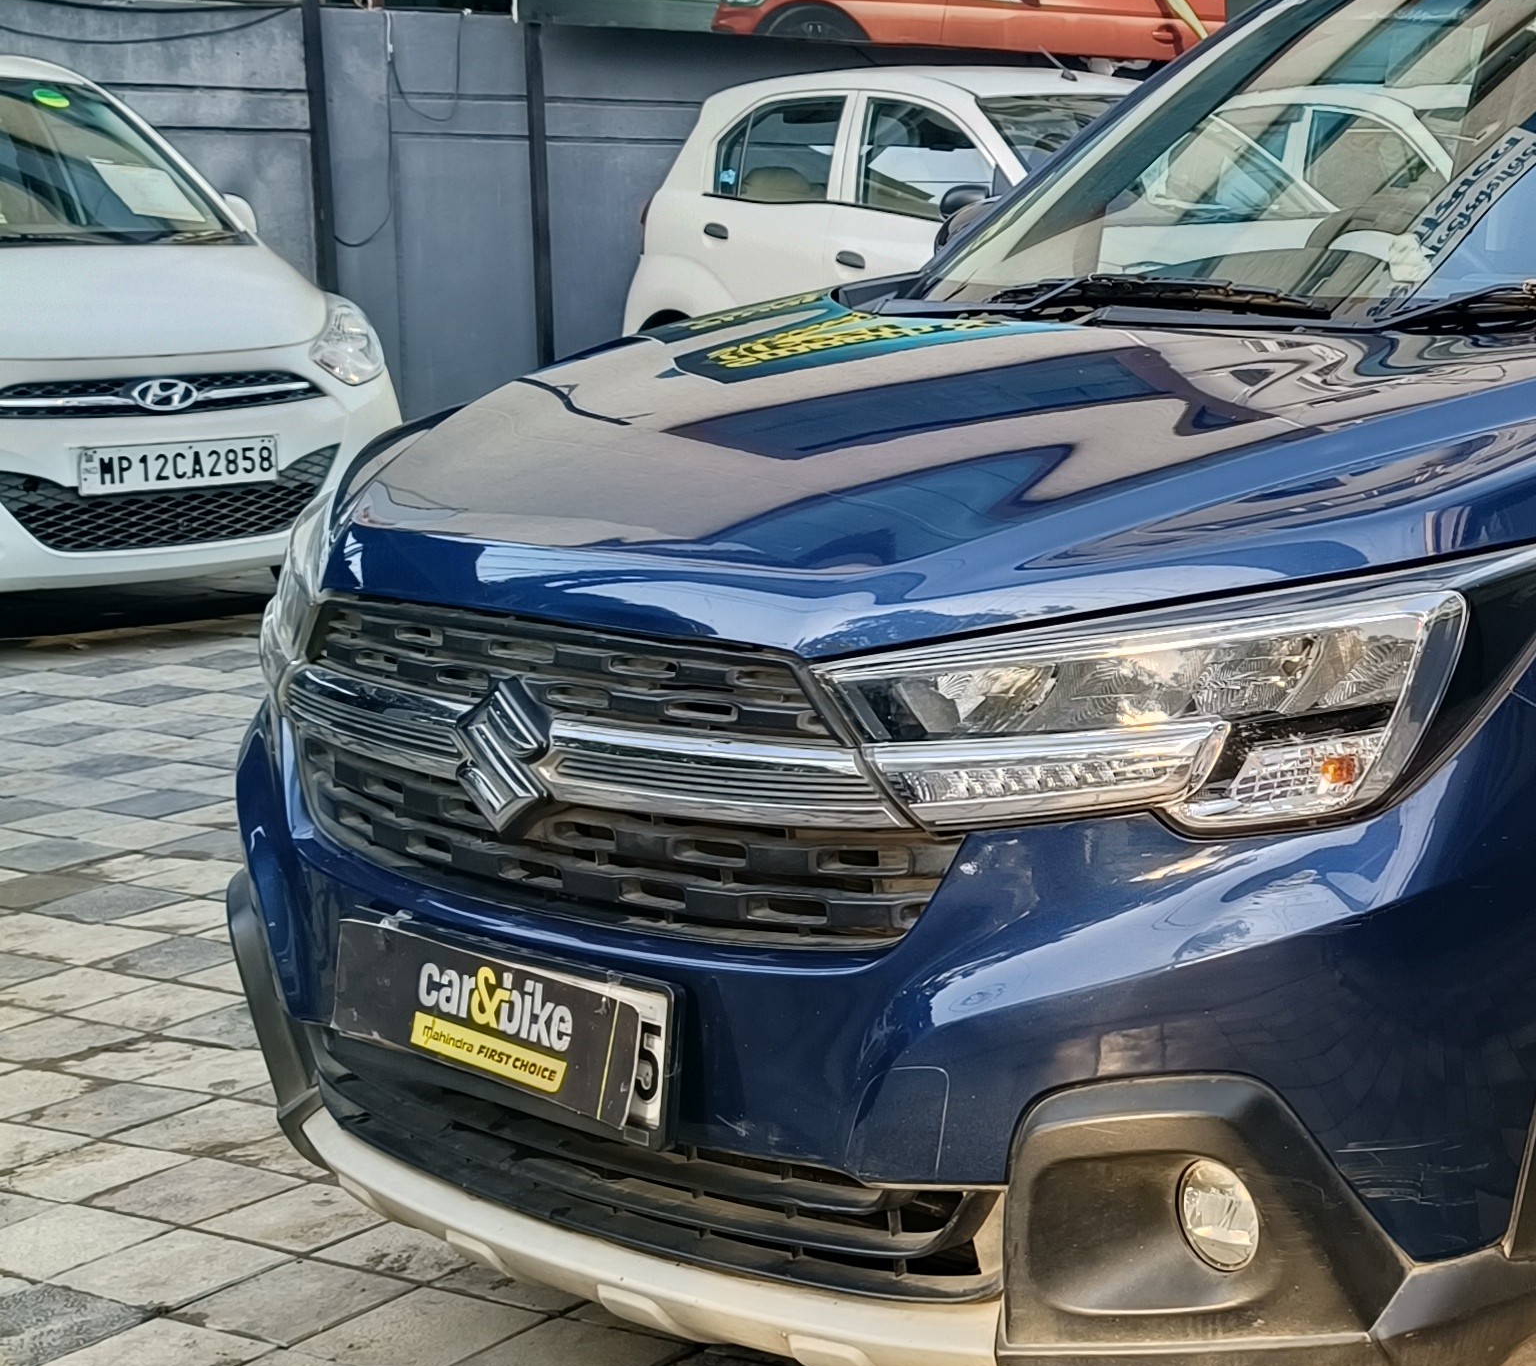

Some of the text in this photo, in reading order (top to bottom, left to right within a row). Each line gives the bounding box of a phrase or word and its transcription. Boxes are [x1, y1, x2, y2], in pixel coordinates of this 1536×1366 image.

[99, 445, 274, 485] MP12CA2858
[418, 962, 573, 1053] car&bike
[476, 1044, 512, 1065] FIRST
[512, 1057, 557, 1082] CHOICE
[634, 1020, 662, 1102] 5
